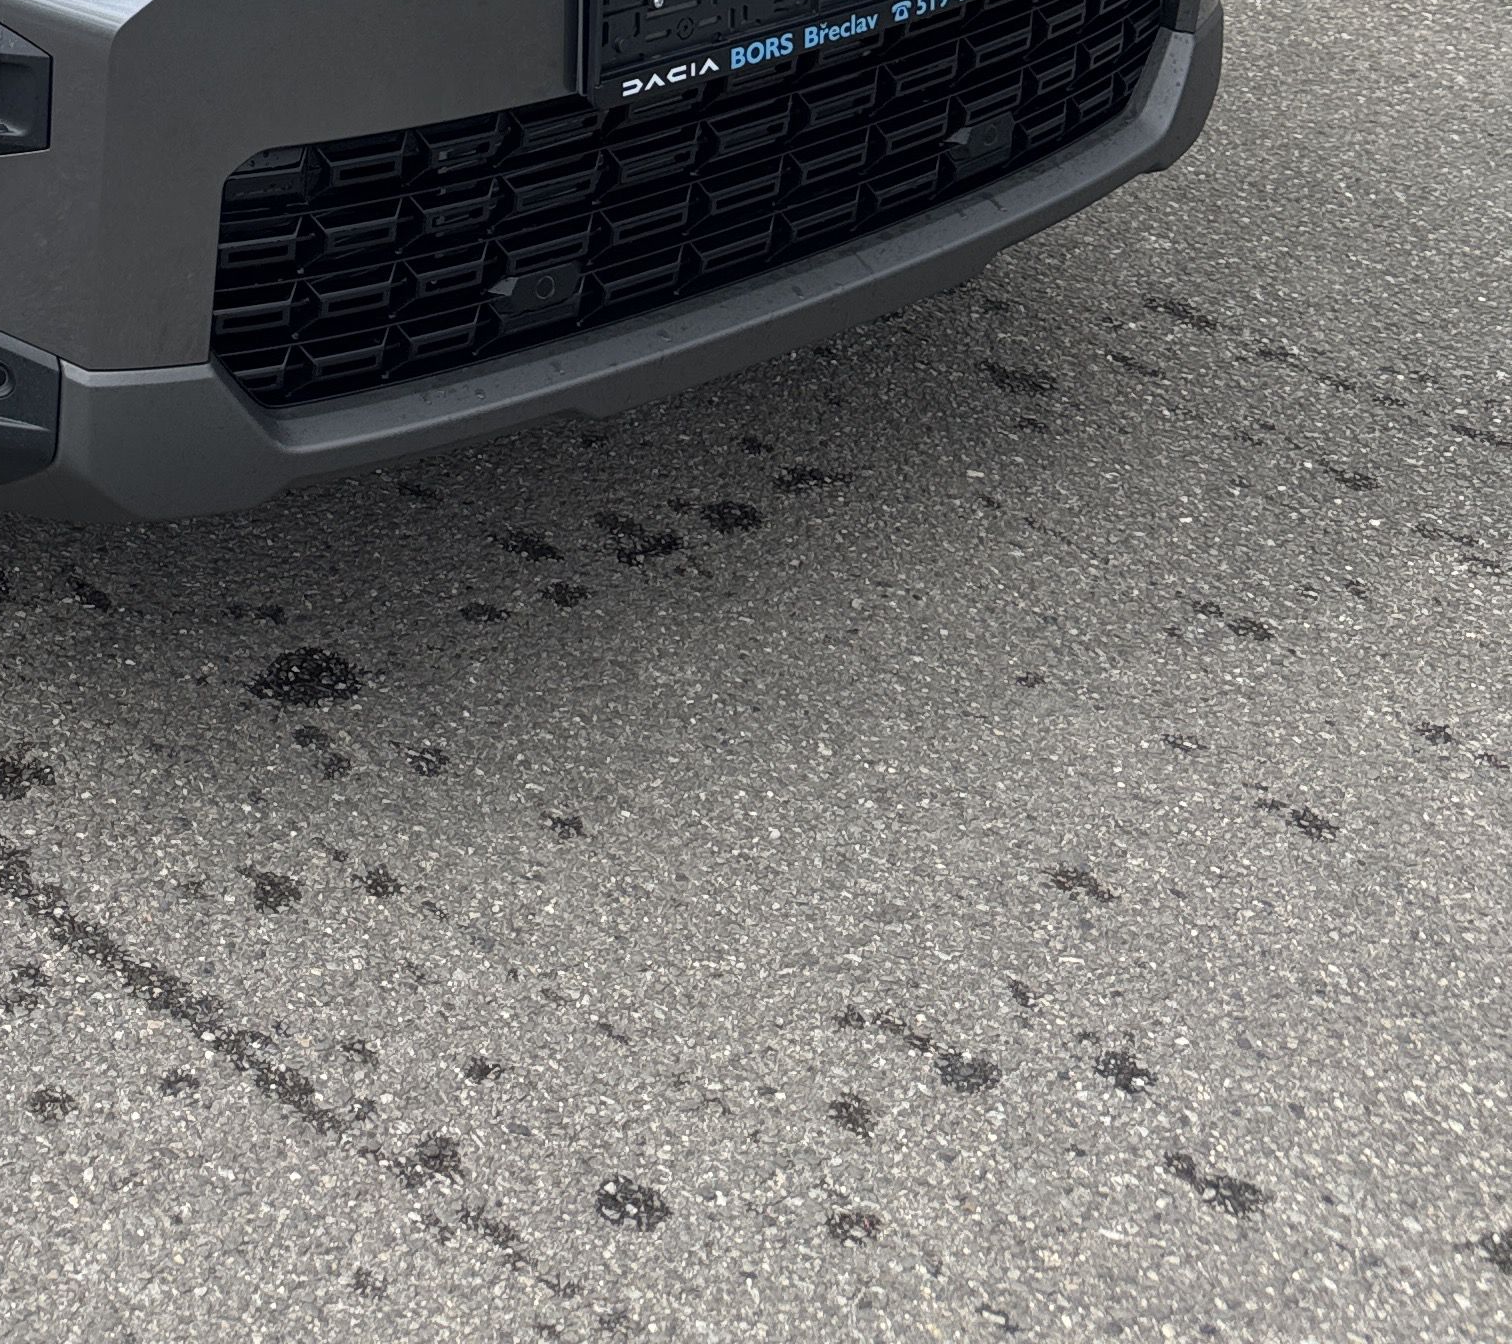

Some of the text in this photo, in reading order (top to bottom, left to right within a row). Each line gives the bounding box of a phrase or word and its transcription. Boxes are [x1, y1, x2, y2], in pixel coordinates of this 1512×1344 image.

[622, 58, 719, 97] DACIA
[730, 33, 794, 70] BORS
[804, 13, 879, 49] Břeclav
